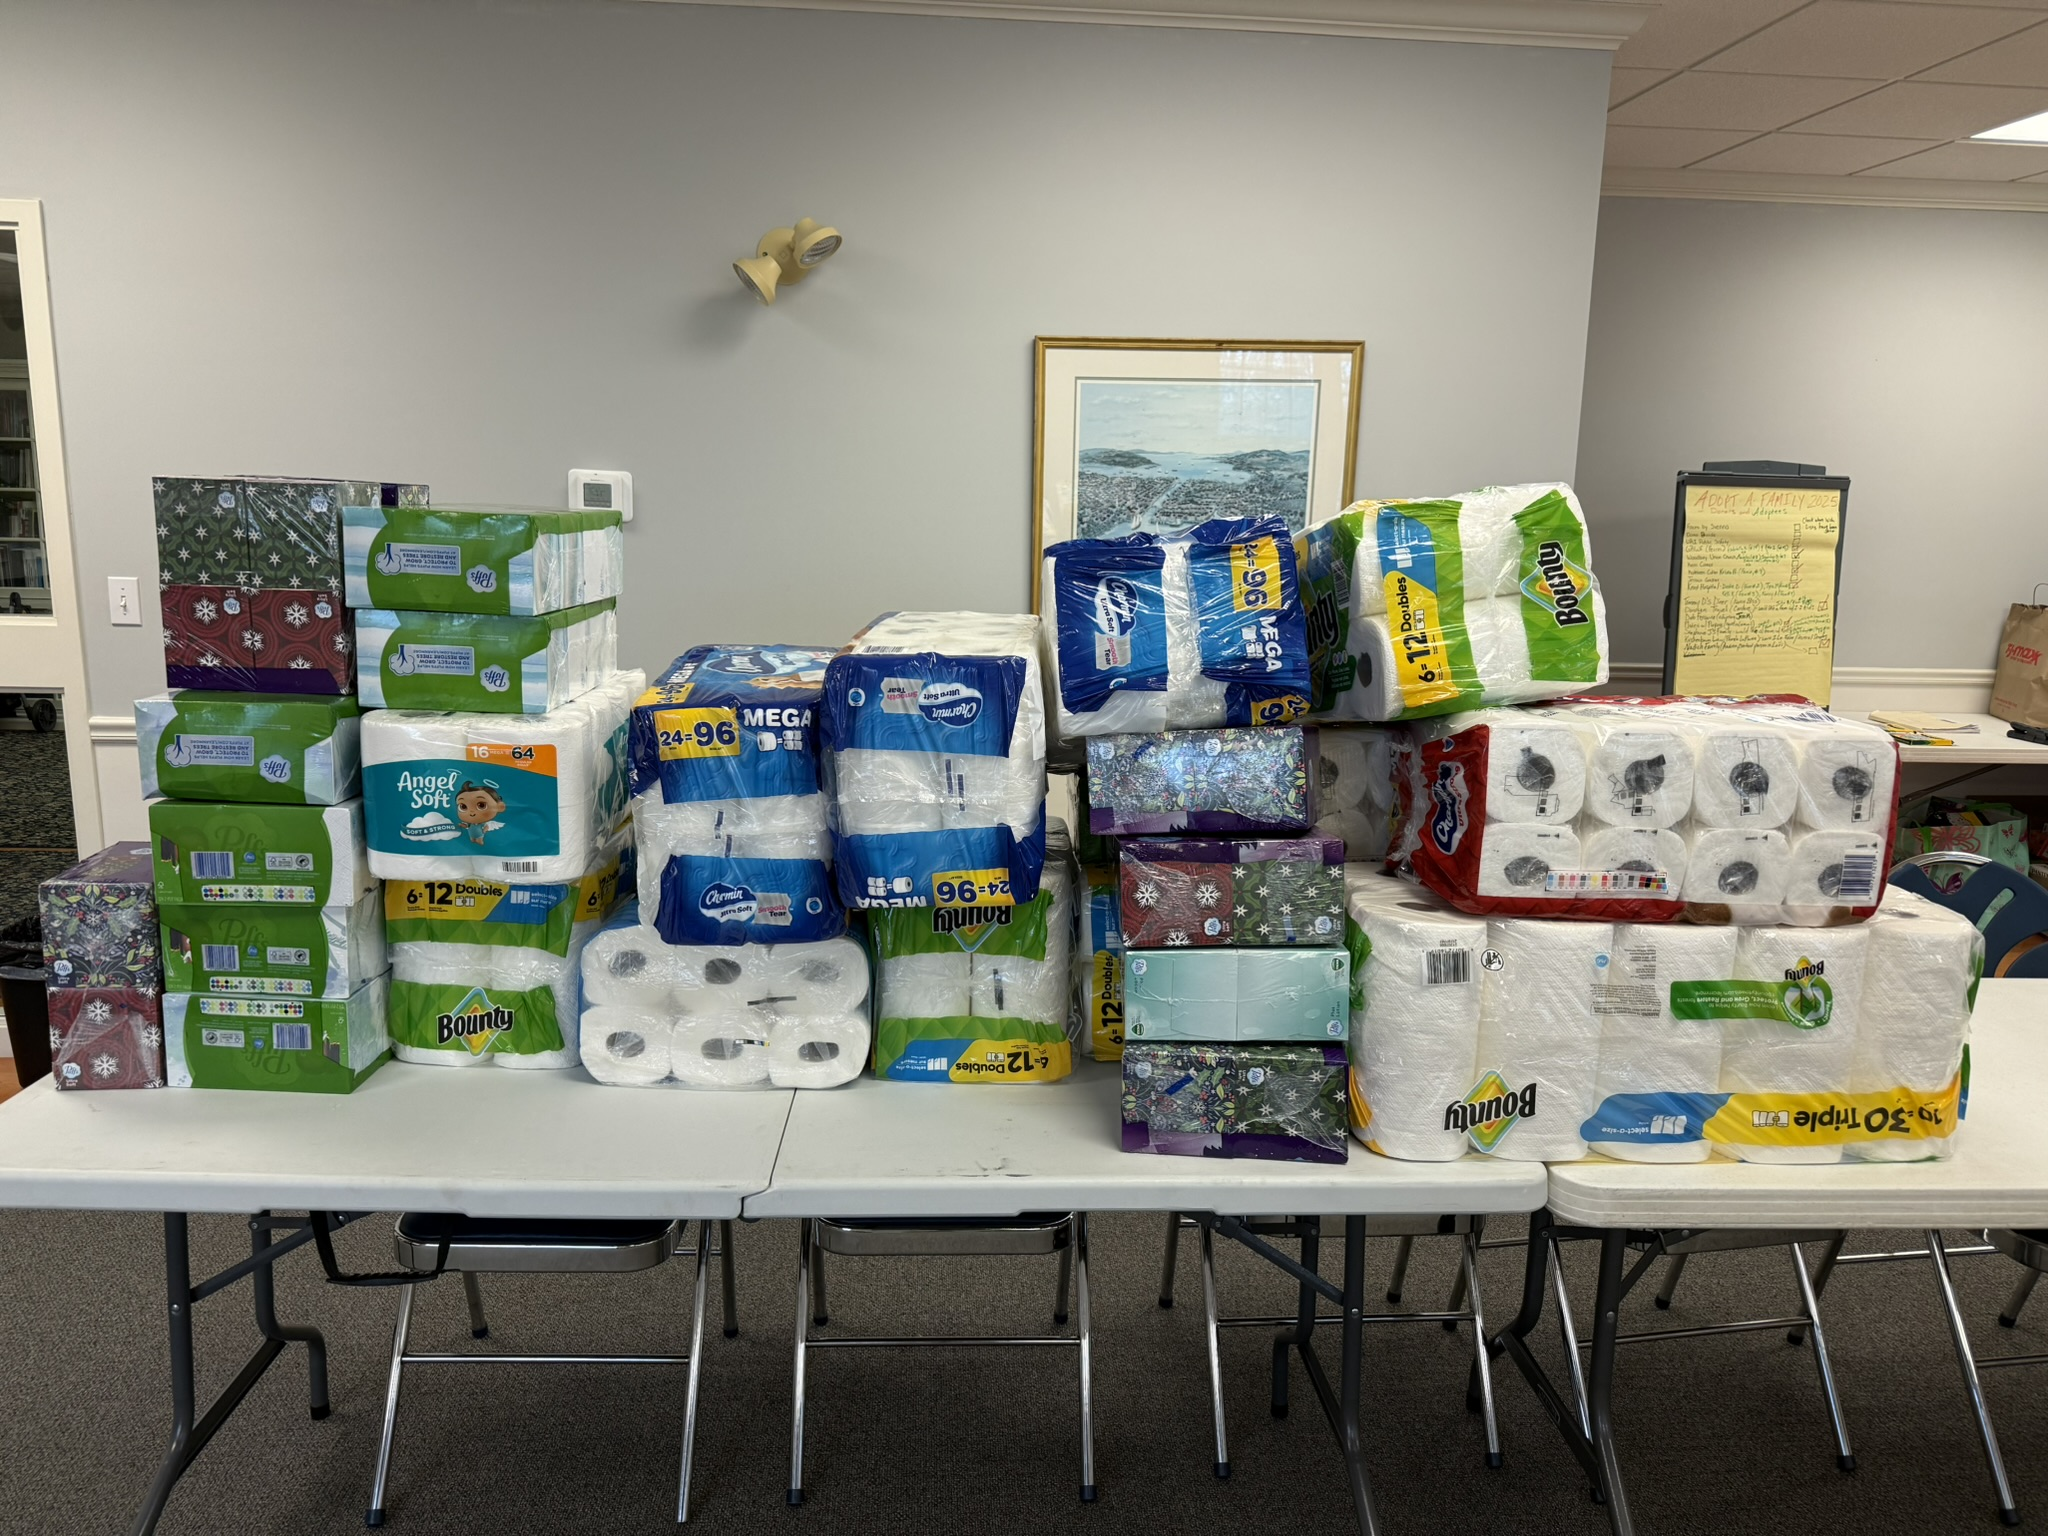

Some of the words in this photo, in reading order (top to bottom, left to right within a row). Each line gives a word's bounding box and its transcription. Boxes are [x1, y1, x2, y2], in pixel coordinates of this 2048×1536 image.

[1694, 490, 1739, 507] ADOPT
[1761, 493, 1805, 510] FAMILY
[1807, 495, 1838, 508] 2025
[1752, 507, 1787, 519] Adoptees
[470, 570, 493, 588] Puffs
[1539, 542, 1589, 628] Bounty
[1400, 576, 1413, 632] Doubles
[1106, 615, 1115, 633] Soft
[1106, 637, 1118, 665] Smooth
[1259, 615, 1283, 673] MEGA
[1104, 648, 1112, 667] Tear
[484, 670, 506, 687] Puffs
[886, 690, 918, 701] Smooth
[923, 693, 939, 701] Soft
[940, 688, 960, 699] Ultra
[743, 708, 812, 727] MEGA
[932, 702, 977, 721] Charmin
[471, 745, 489, 759] 16
[511, 746, 535, 760] 64
[264, 760, 287, 778] Puffs
[397, 770, 458, 793] Angel
[411, 790, 450, 809] Soft
[429, 824, 456, 833] STRONG
[455, 883, 503, 898] Doubles
[736, 905, 753, 915] Soft
[757, 905, 787, 914] Smooth
[1102, 955, 1114, 1000] Doubles
[1785, 960, 1824, 982] Bounty
[437, 1004, 514, 1044] Bounty
[955, 1062, 1005, 1074] Doubles
[1444, 1083, 1537, 1133] Bounty
[1794, 1104, 1857, 1132] Triple
[1601, 1126, 1649, 1135] select-a-size
